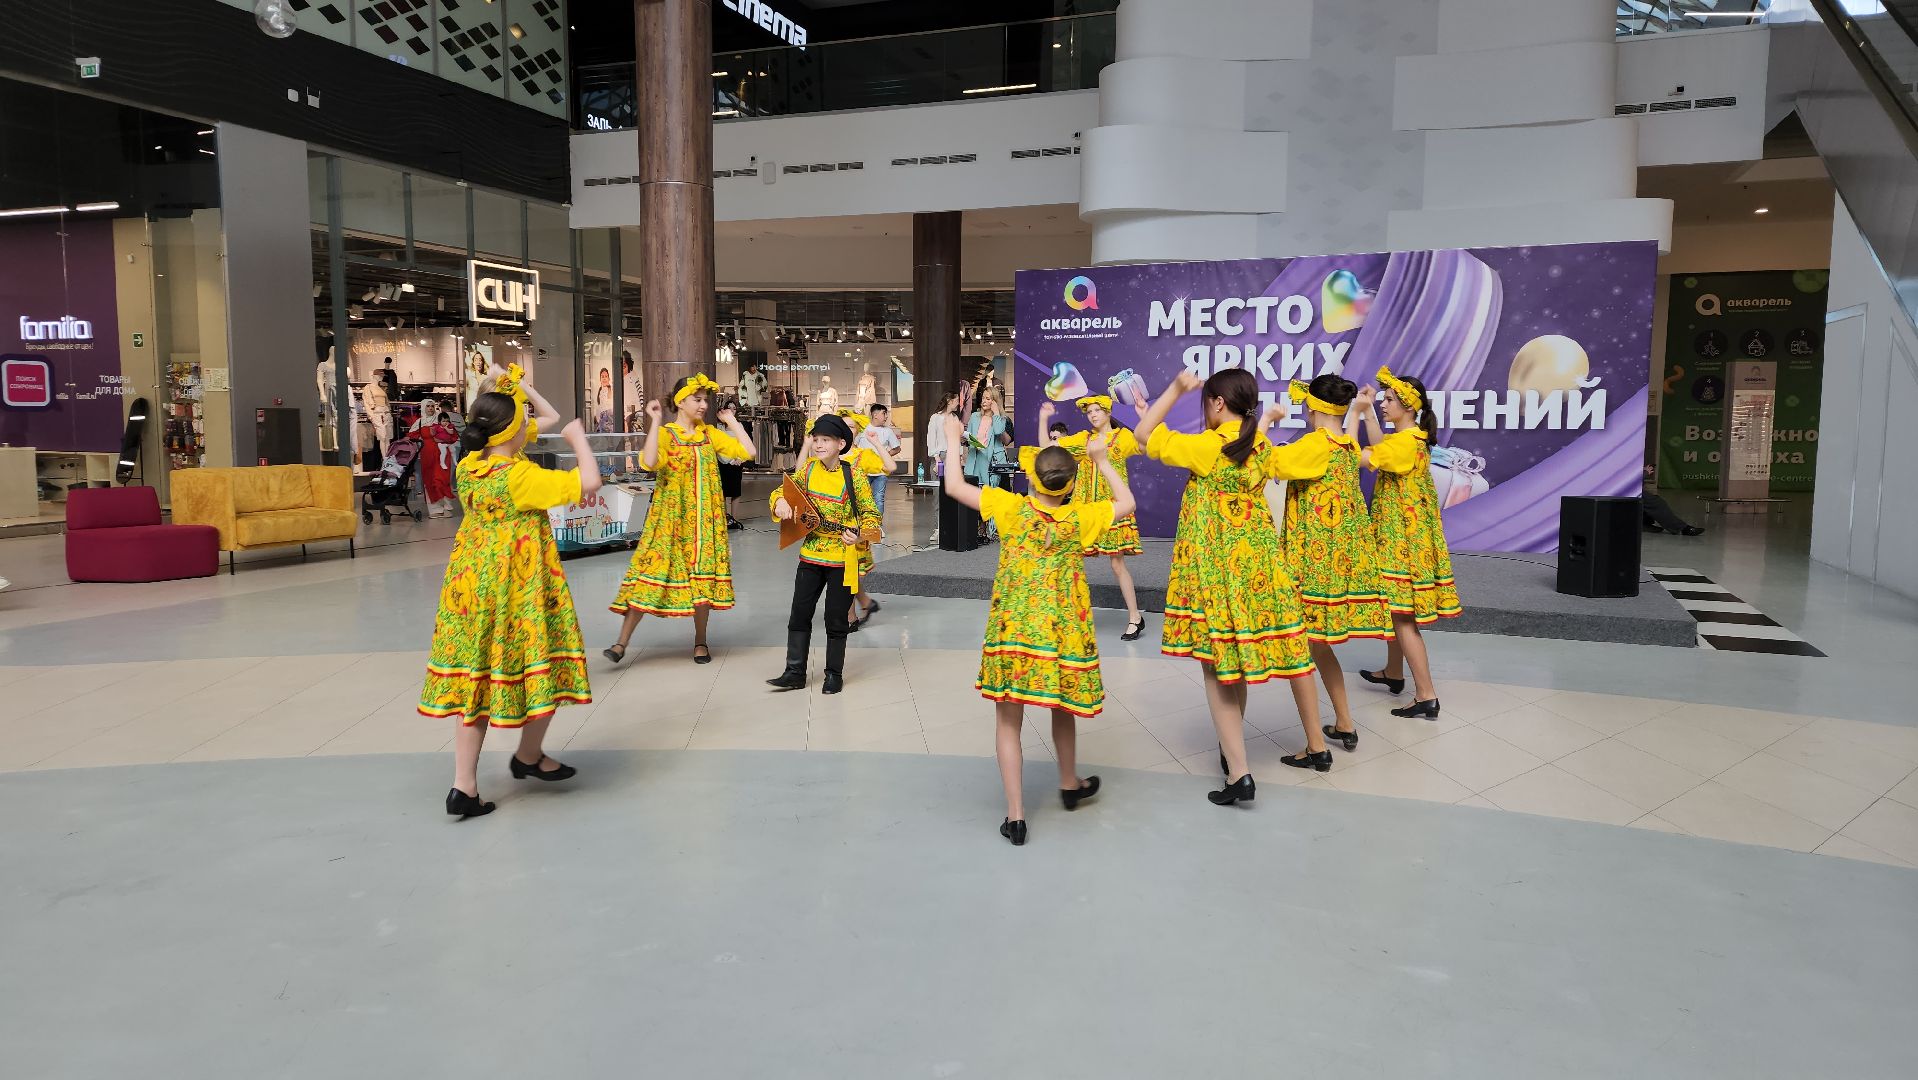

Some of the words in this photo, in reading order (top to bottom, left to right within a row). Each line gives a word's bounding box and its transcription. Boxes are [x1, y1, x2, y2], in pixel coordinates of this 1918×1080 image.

[1727, 297, 1792, 307] акварель
[1147, 294, 1314, 337] МЕСТО
[20, 315, 93, 340] familia
[1040, 317, 1123, 331] акварель
[1182, 342, 1352, 382] ЯРКИХ
[99, 374, 131, 384] ТОВАРЫ
[95, 386, 112, 396] ДЛЯ
